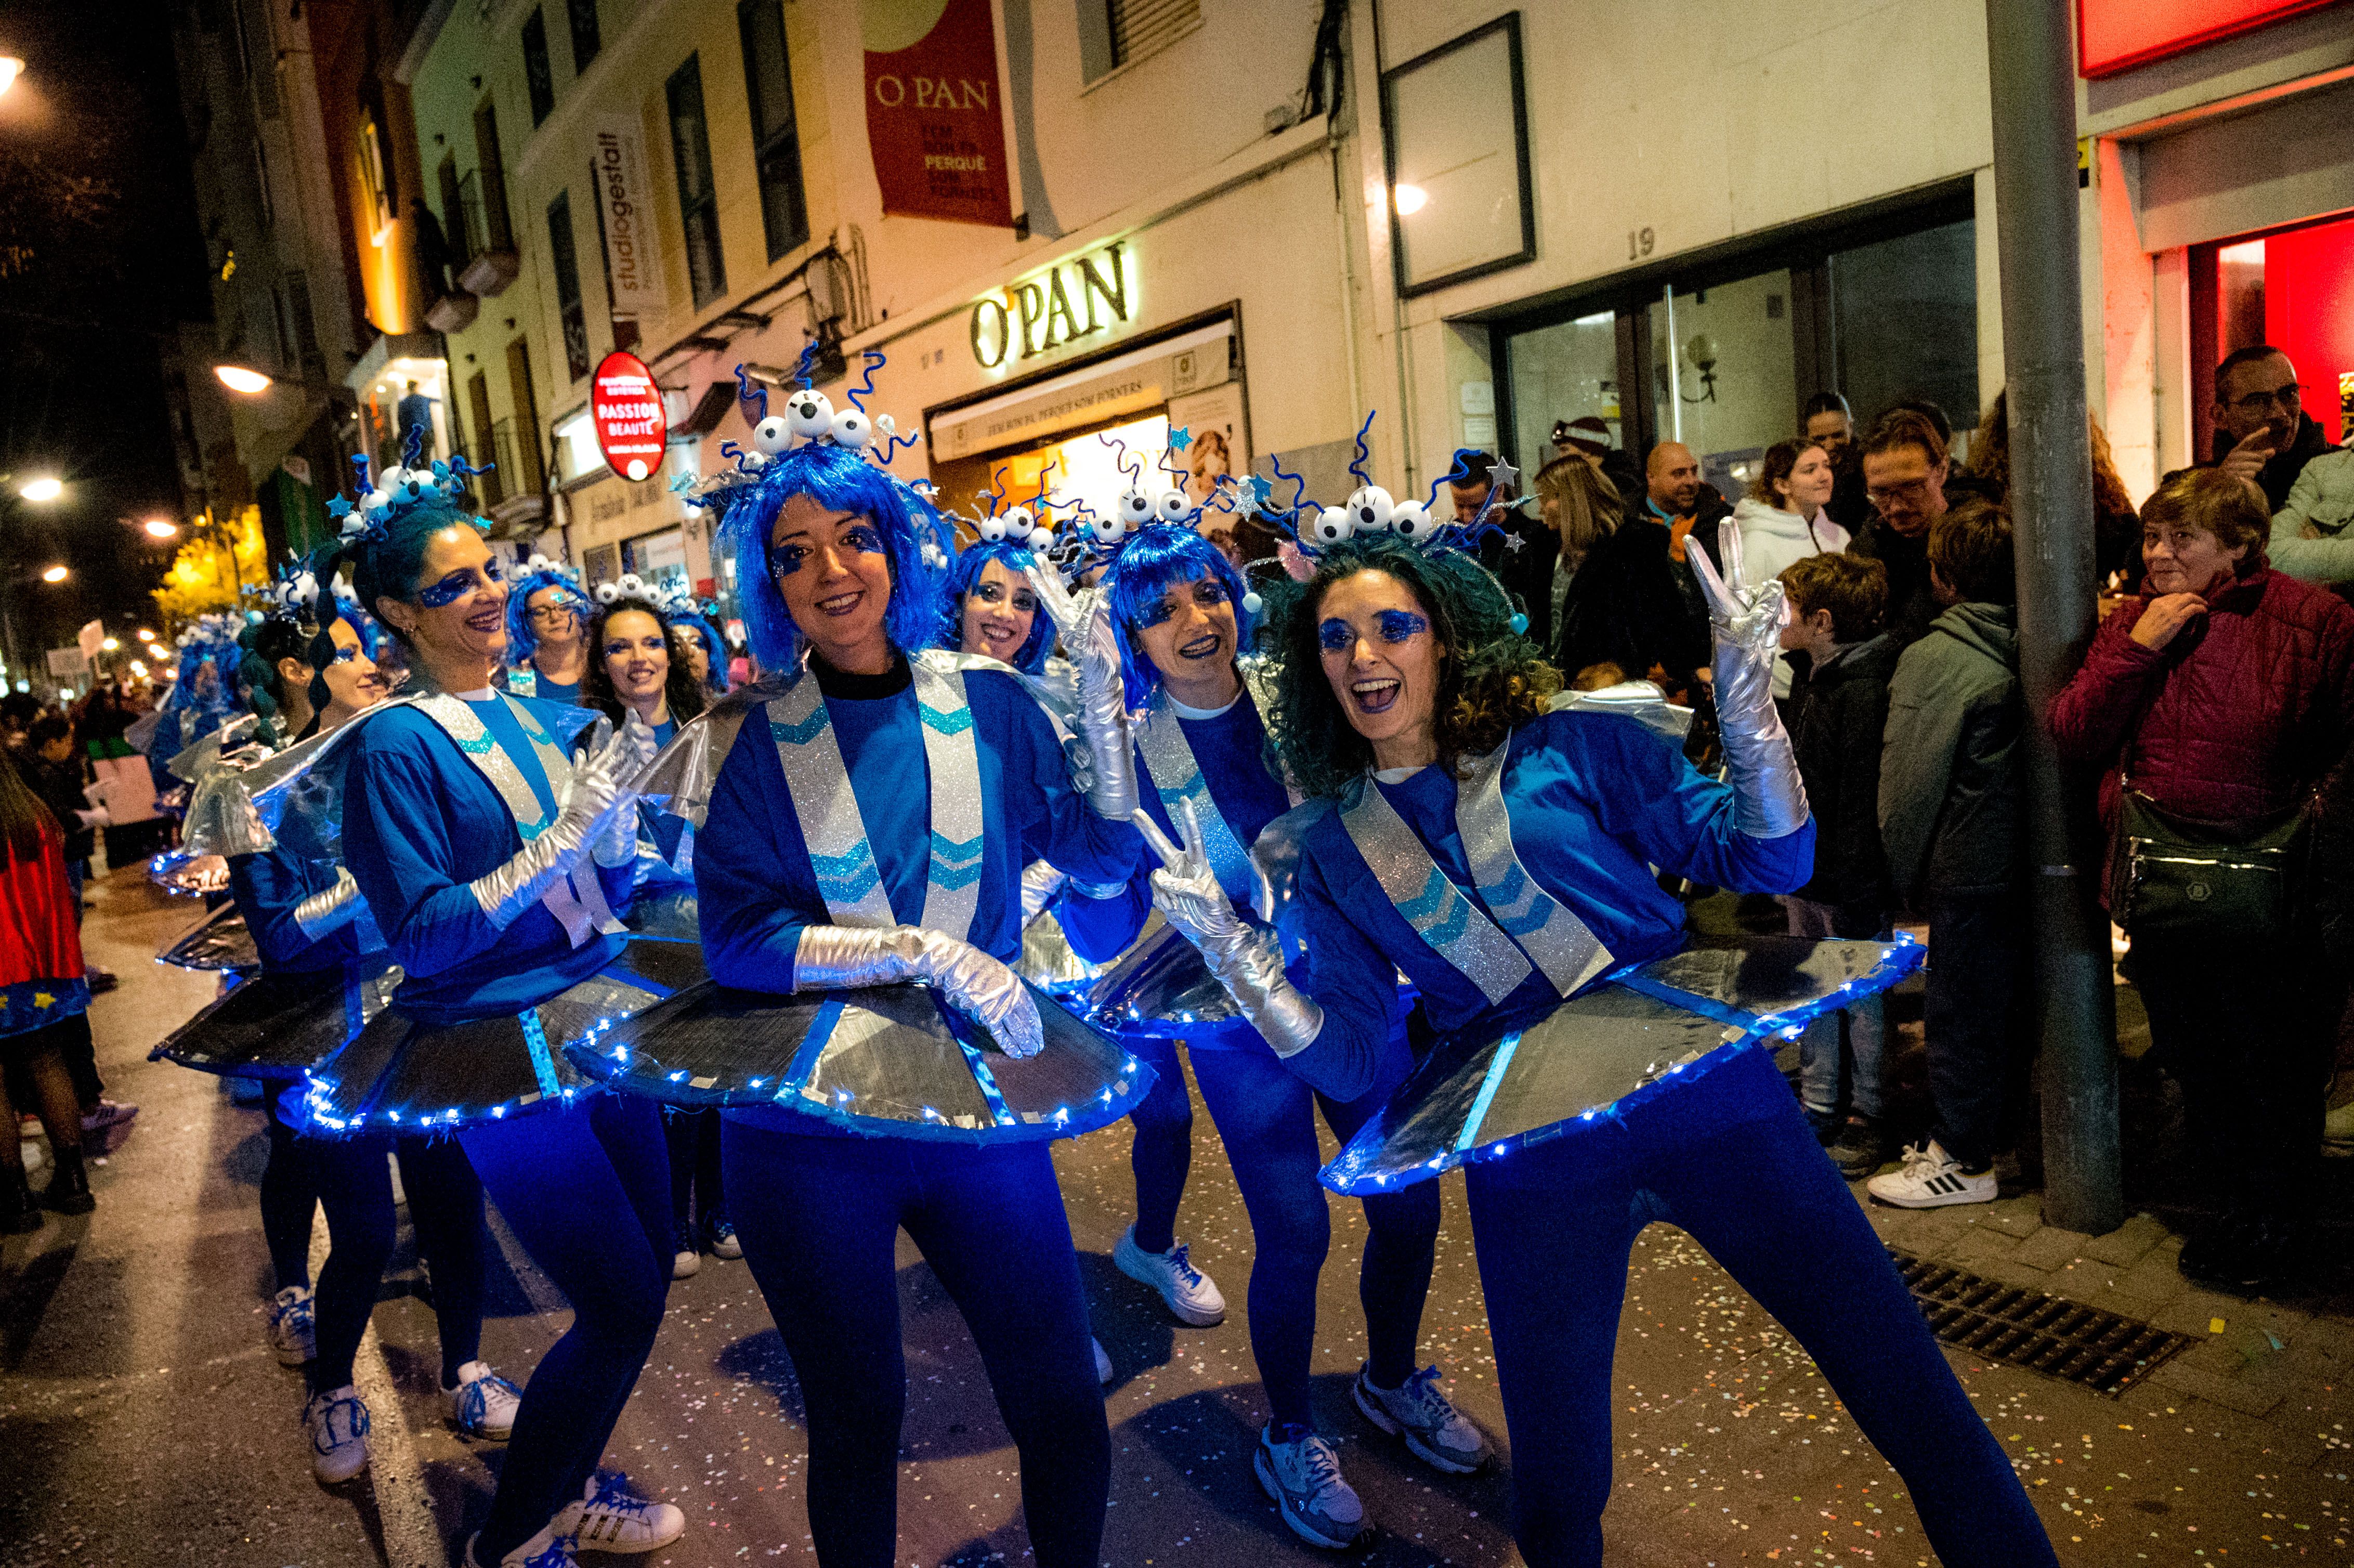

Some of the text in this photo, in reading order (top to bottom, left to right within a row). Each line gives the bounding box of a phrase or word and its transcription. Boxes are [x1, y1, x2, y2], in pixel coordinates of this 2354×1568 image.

[875, 75, 988, 111] O PAN
[598, 133, 638, 291] studiogestalt
[1628, 227, 1654, 260] 19
[598, 402, 660, 419] PASSION
